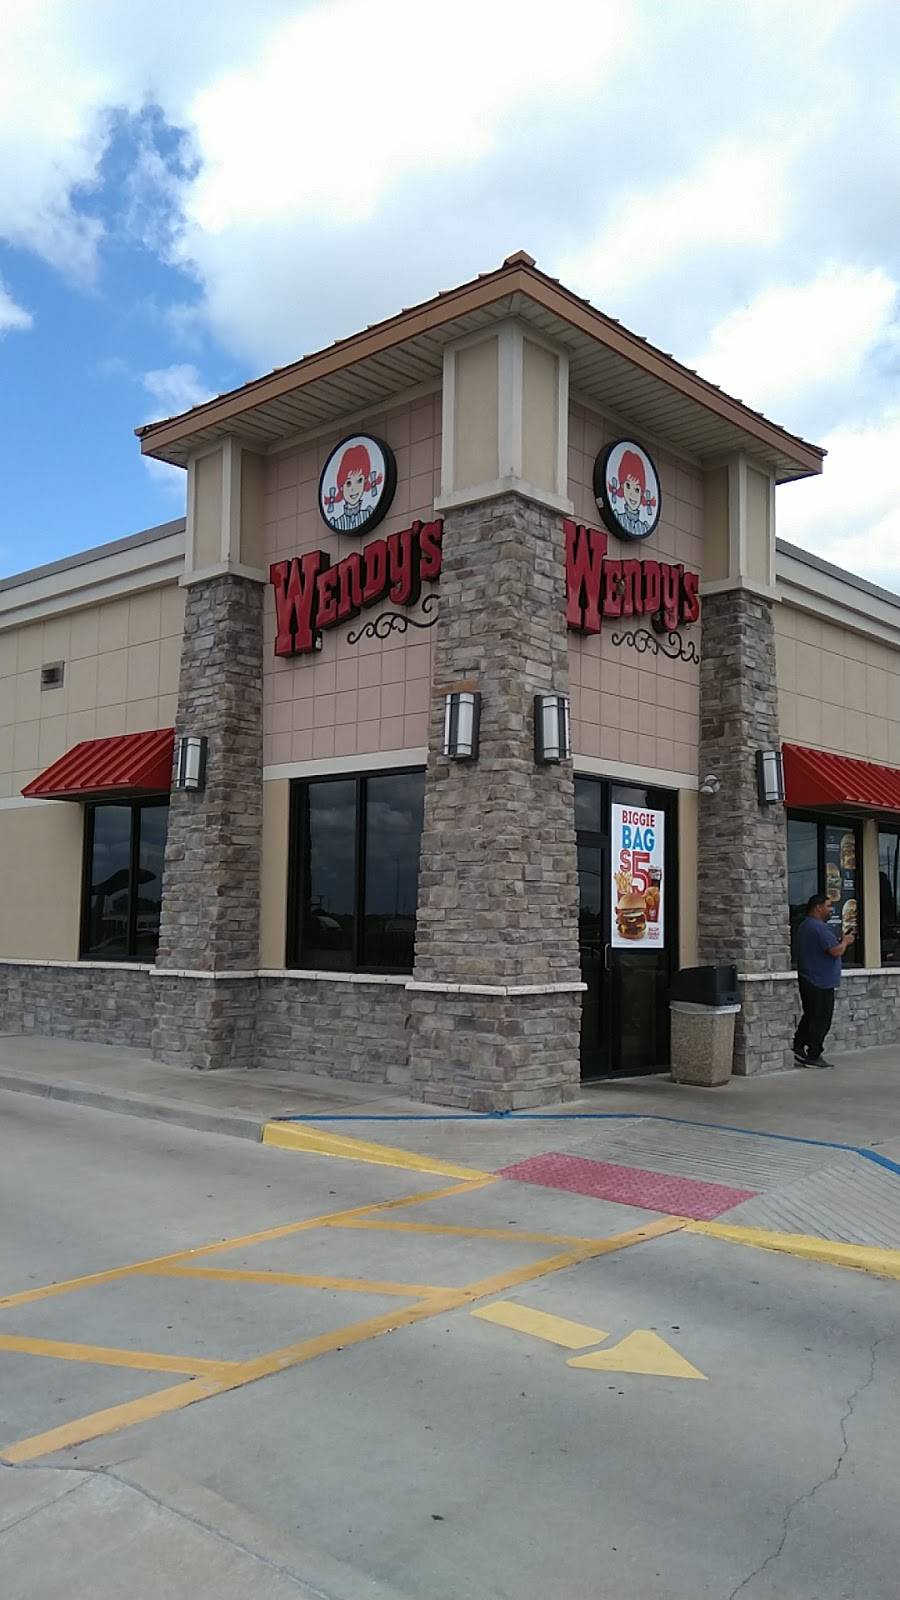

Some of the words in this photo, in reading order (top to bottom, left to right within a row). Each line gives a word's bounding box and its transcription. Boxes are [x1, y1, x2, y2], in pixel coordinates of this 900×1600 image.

[622, 810, 655, 827] BIGGIE
[622, 825, 655, 852] BAG
[619, 848, 651, 898] $5
